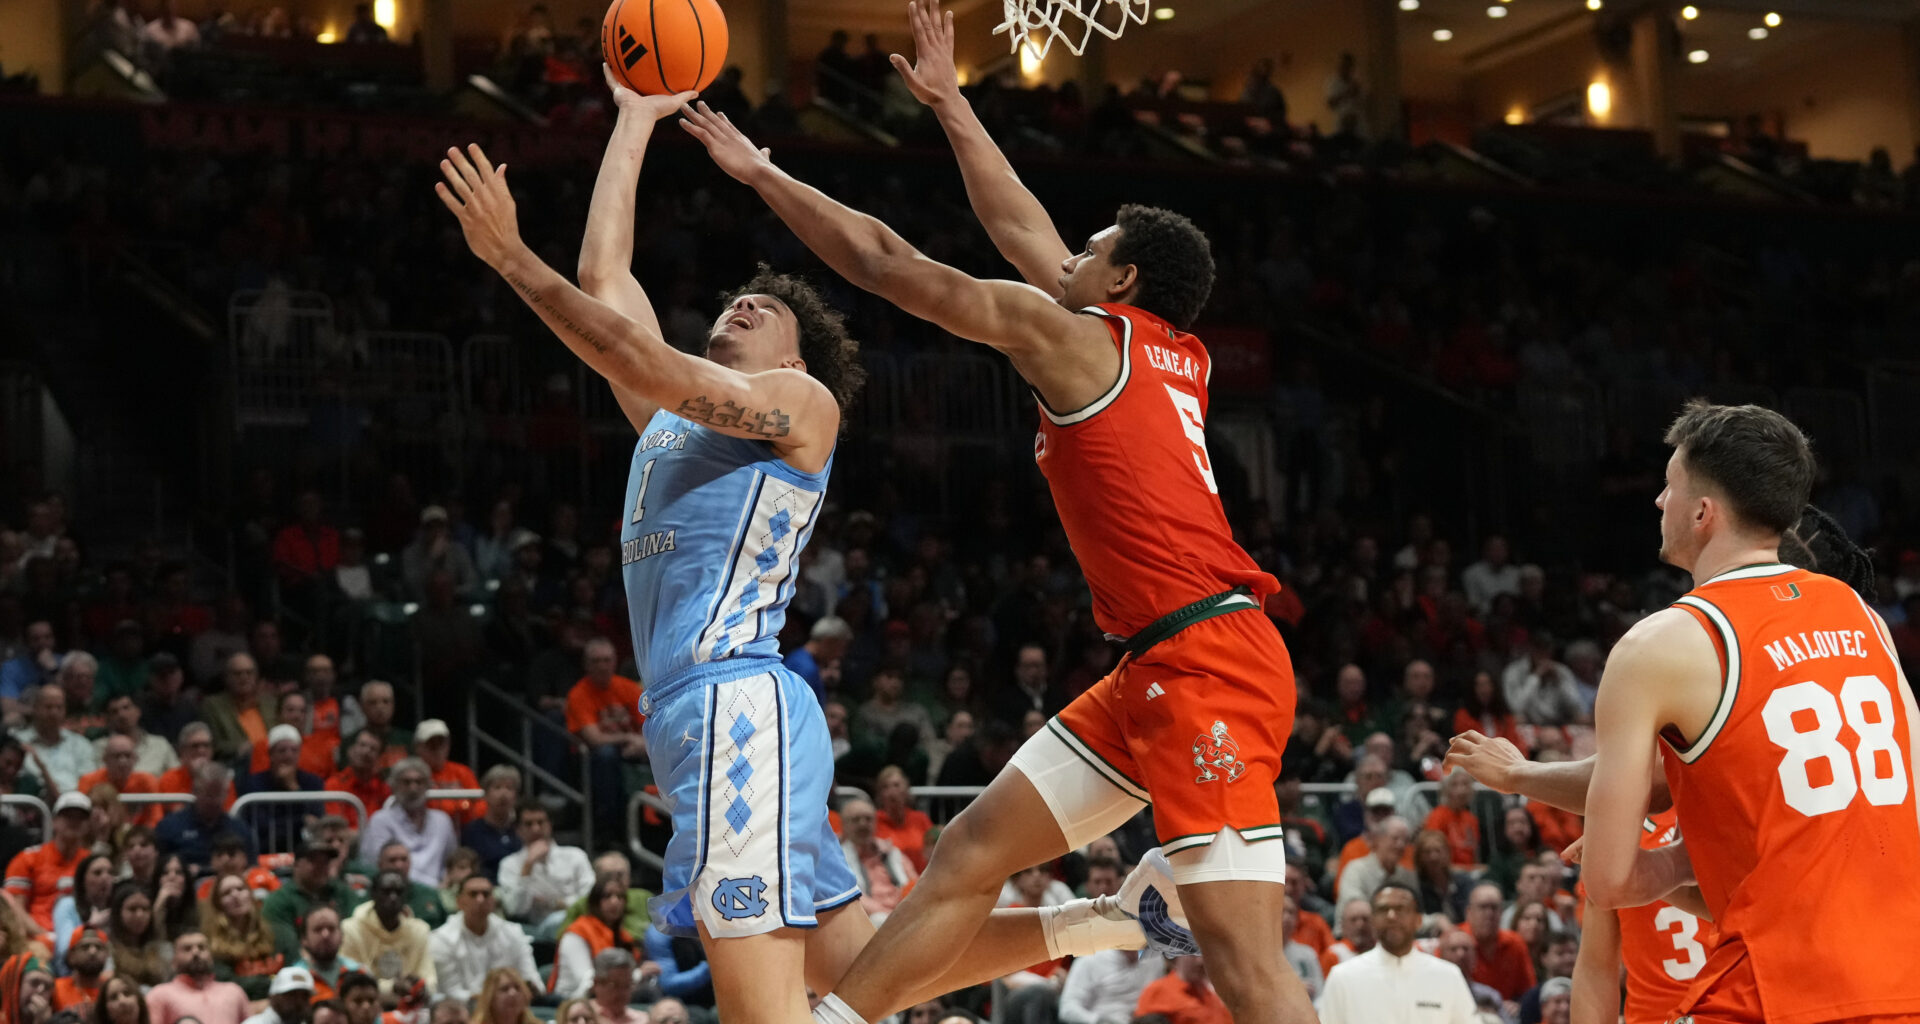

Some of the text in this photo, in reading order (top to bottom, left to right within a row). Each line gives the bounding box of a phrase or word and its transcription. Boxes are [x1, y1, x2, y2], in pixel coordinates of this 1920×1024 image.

[1163, 383, 1218, 494] 5
[631, 458, 657, 525] 1
[622, 529, 676, 566] ROLINA
[1770, 582, 1802, 602] U
[1763, 630, 1868, 672] MALOVEC
[1761, 675, 1909, 818] 88
[1654, 905, 1708, 981] 3
